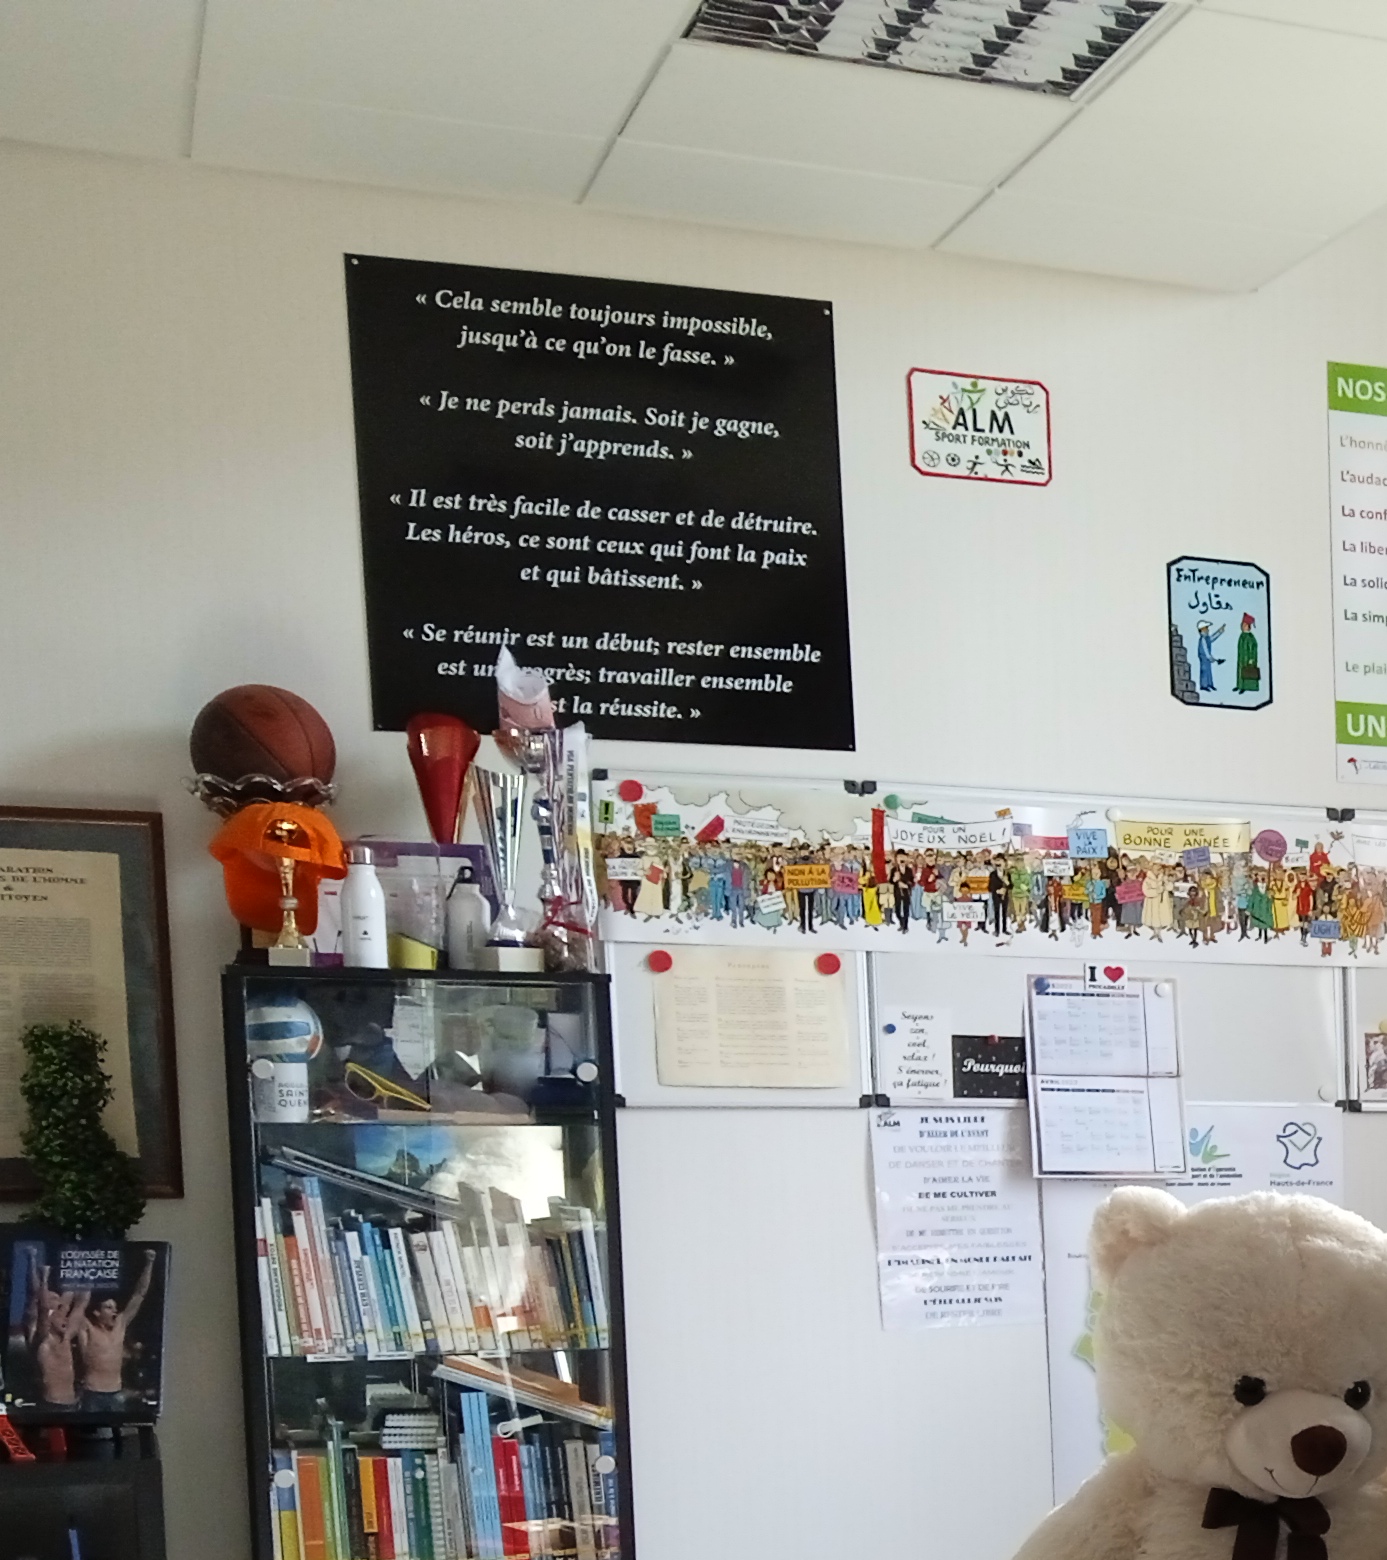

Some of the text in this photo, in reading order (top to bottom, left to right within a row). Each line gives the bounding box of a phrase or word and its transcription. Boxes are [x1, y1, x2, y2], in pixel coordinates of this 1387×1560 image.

[435, 290, 772, 340] Cela semble toujours impossible,
[658, 343, 716, 366] fasse.
[1338, 377, 1386, 402] NOS
[438, 391, 779, 438] Je perds jamais. Soit gagne,
[952, 408, 1015, 435] ALM
[515, 432, 553, 449] soit
[935, 431, 1030, 450] SPORT FORMATION
[409, 489, 817, 535] Il très facile casser détruire.
[406, 523, 807, 569] Les héros, sont ceux qui font paix
[547, 566, 683, 590] qui bâtissent.
[422, 624, 821, 662] Se réunir début; rester ensemble
[599, 668, 793, 692] travailler ensemble
[600, 698, 682, 718] réussite.
[1347, 714, 1386, 738] UN
[893, 829, 997, 844] JOYEUX NOËL
[923, 825, 965, 834] POUR UN
[1075, 831, 1098, 841] VIVE
[1147, 826, 1205, 836] POUR UNE
[1077, 845, 1098, 855] PAIX
[1123, 835, 1231, 849] BONNE ANNÉE
[787, 868, 804, 877] NON
[787, 877, 829, 887] POLLUTION
[1312, 922, 1332, 935] UGH
[961, 1058, 1026, 1077] Pourquoi
[61, 1260, 119, 1268] LA NATATION
[107, 1250, 119, 1259] DE
[60, 1269, 118, 1279] FRANÇAISE
